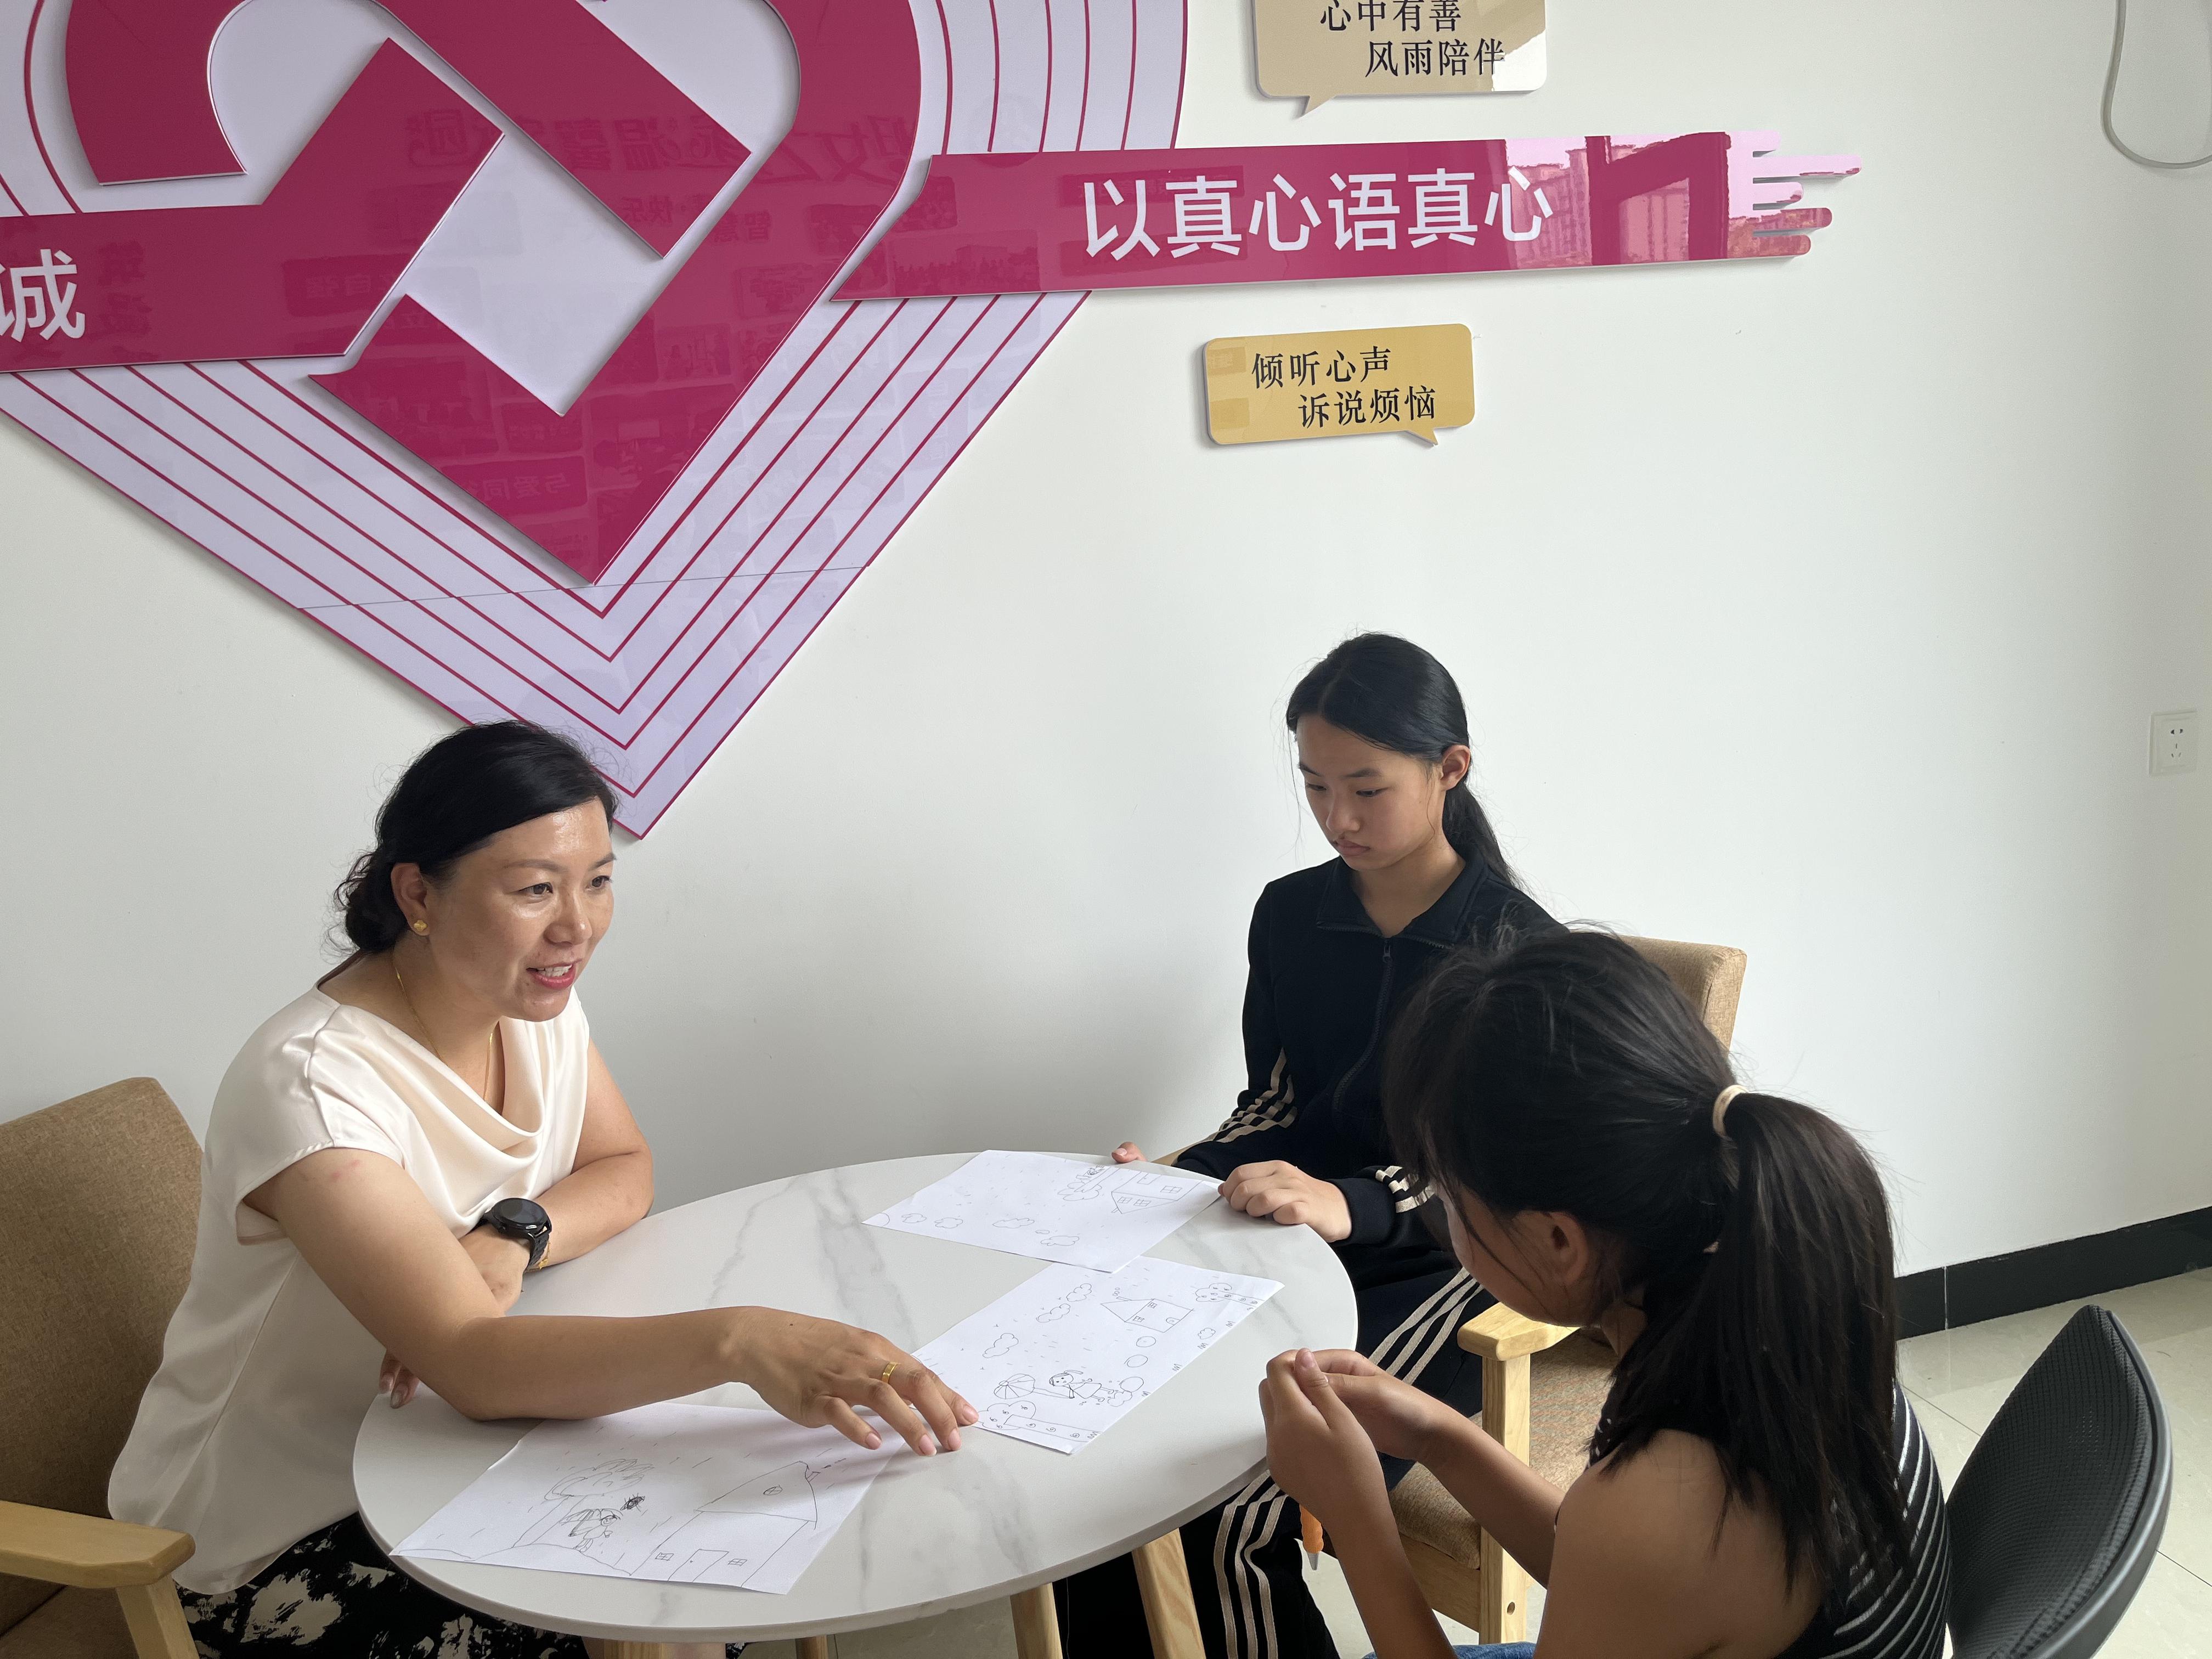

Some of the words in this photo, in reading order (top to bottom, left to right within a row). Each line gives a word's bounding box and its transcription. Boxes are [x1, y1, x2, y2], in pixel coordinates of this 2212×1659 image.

[1320, 0, 1462, 32] 心中有善
[1365, 38, 1506, 77] 风雨陪伴
[1084, 166, 1554, 262] 以真心语真心
[0, 248, 86, 343] 诚
[1251, 345, 1391, 390] 倾听心声
[1297, 385, 1436, 428] 诉说烦恼
